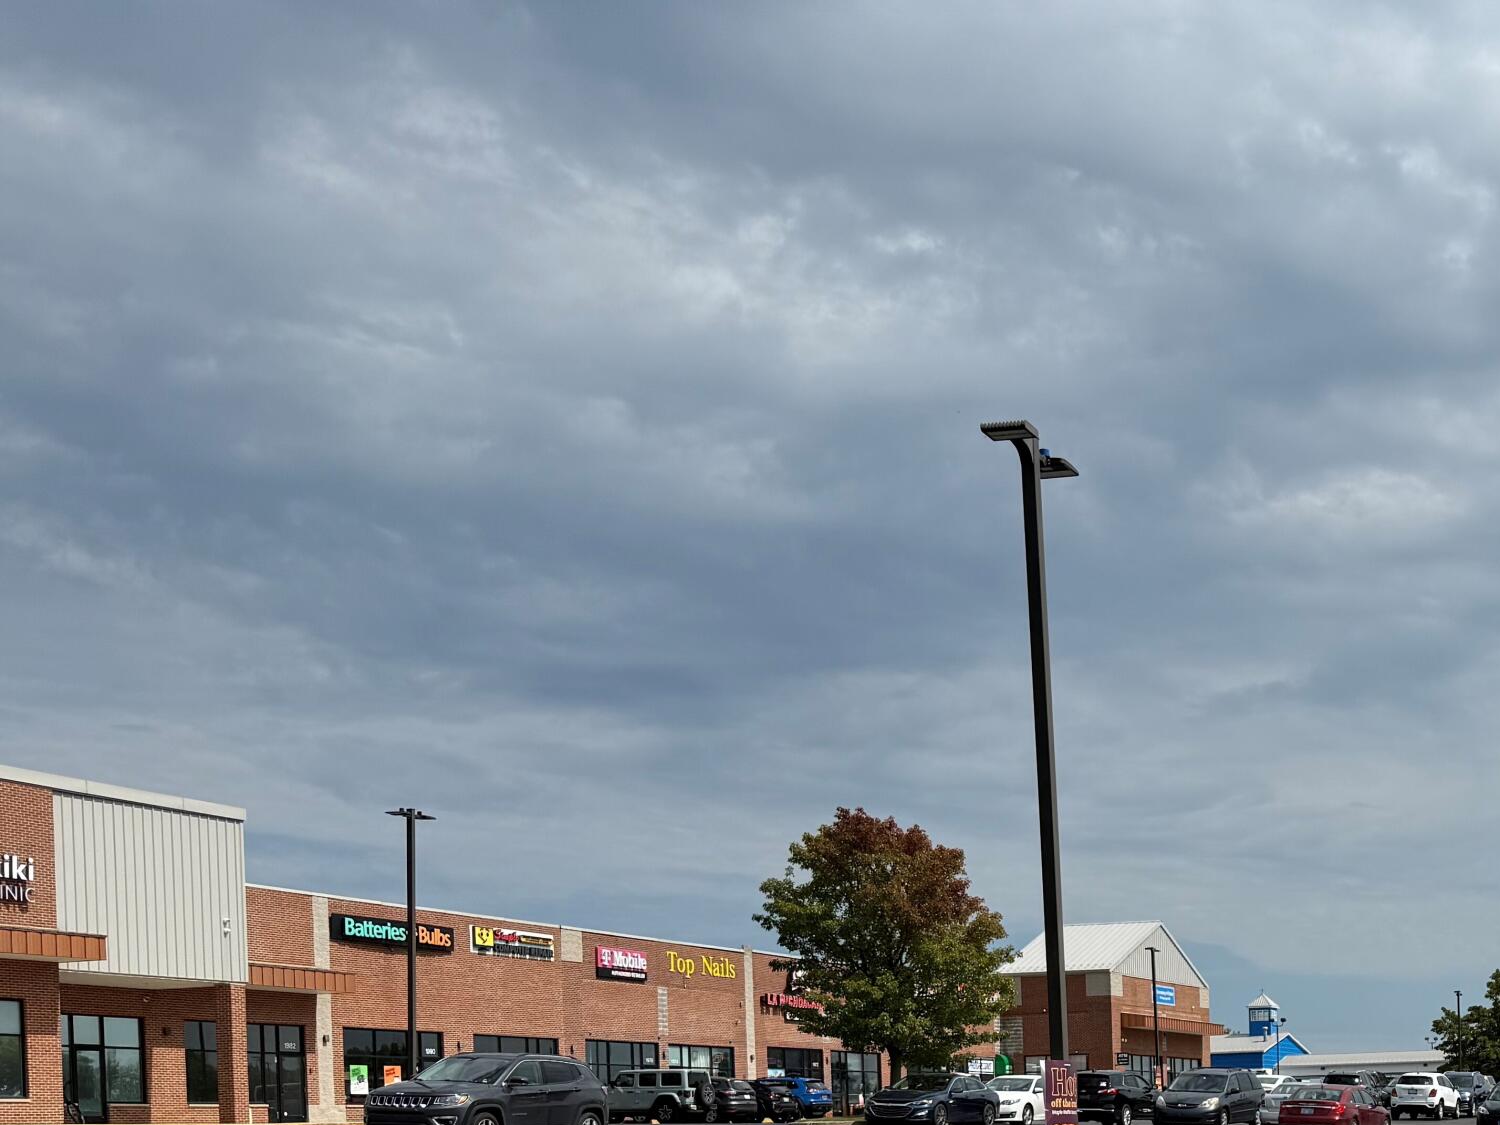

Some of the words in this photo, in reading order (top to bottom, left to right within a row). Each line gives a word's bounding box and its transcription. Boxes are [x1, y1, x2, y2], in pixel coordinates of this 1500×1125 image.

[0, 854, 34, 881] iki
[344, 917, 407, 941] Batteries
[418, 925, 452, 947] Bulbs
[612, 950, 647, 970] Mobile
[666, 951, 695, 979] Top
[700, 955, 736, 979] Nails
[1051, 1098, 1062, 1108] off
[1062, 1097, 1071, 1108] the
